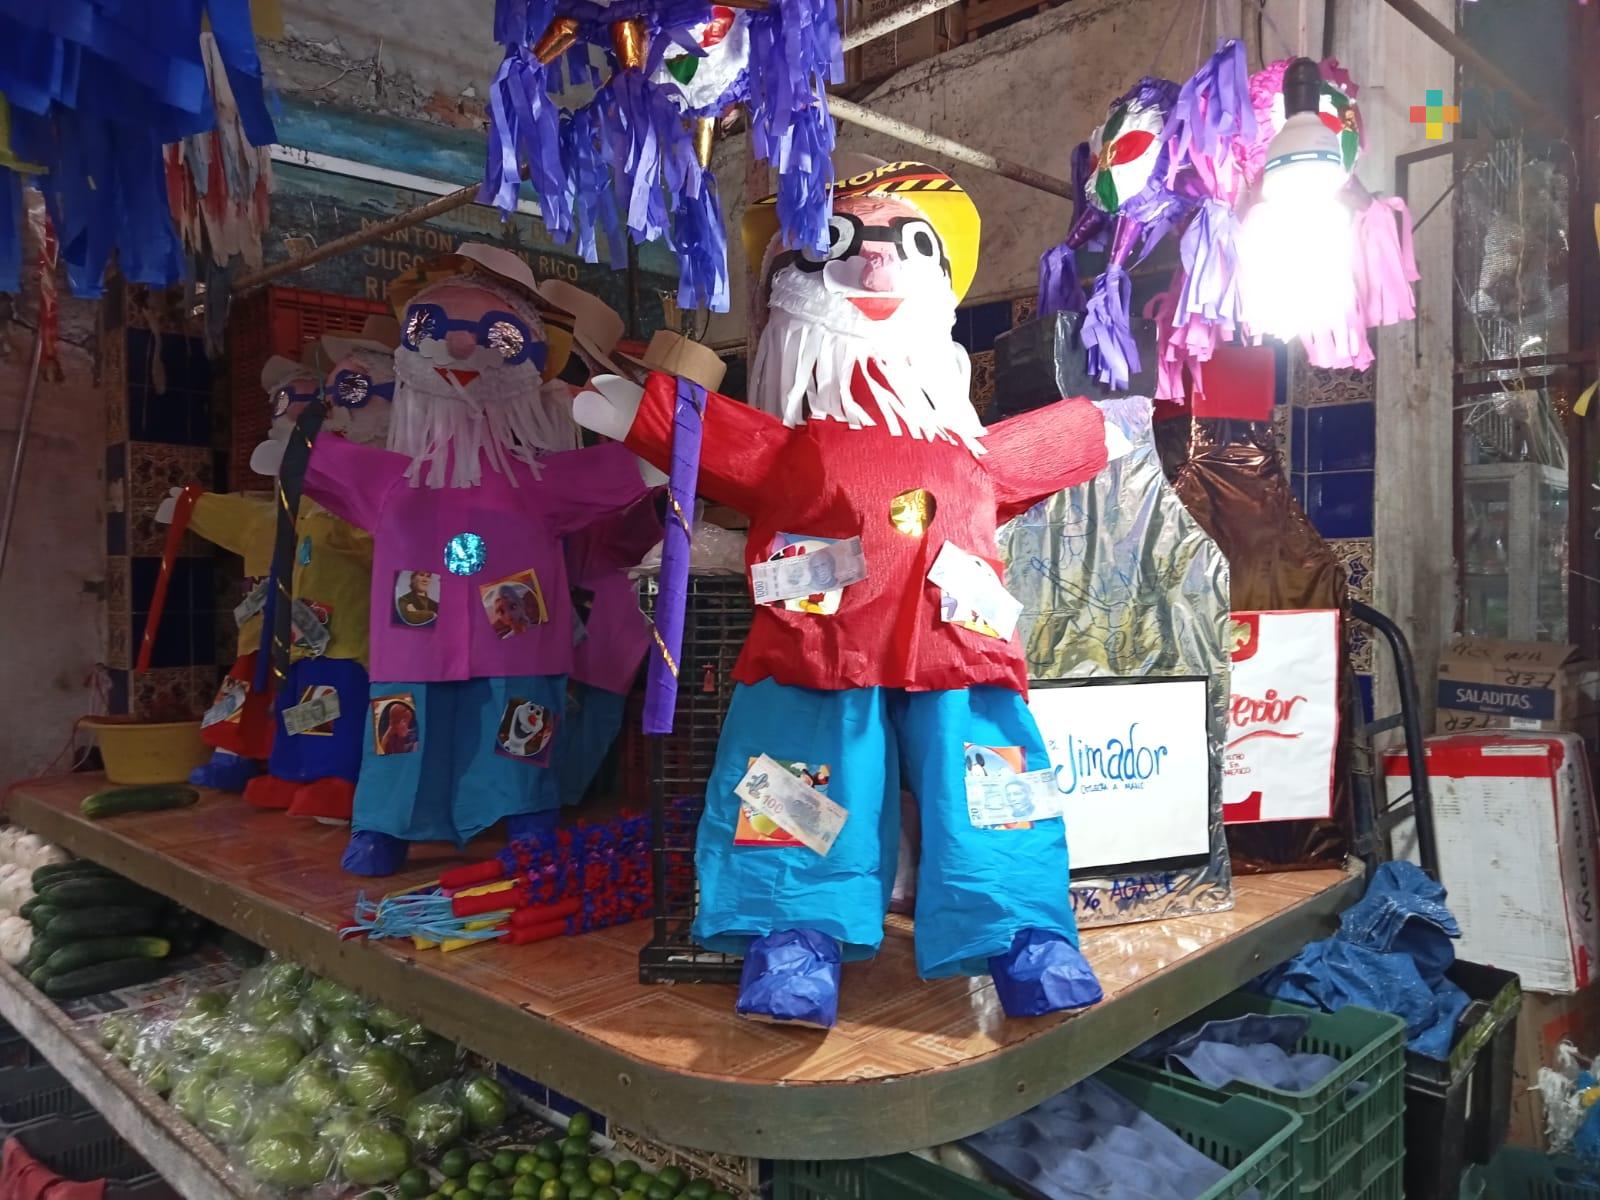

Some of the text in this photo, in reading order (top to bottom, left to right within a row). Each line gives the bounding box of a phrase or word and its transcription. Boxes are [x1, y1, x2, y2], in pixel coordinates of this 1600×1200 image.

[539, 255, 578, 281] RICO
[1456, 688, 1530, 710] SALADITAS
[1055, 722, 1168, 794] Jimador
